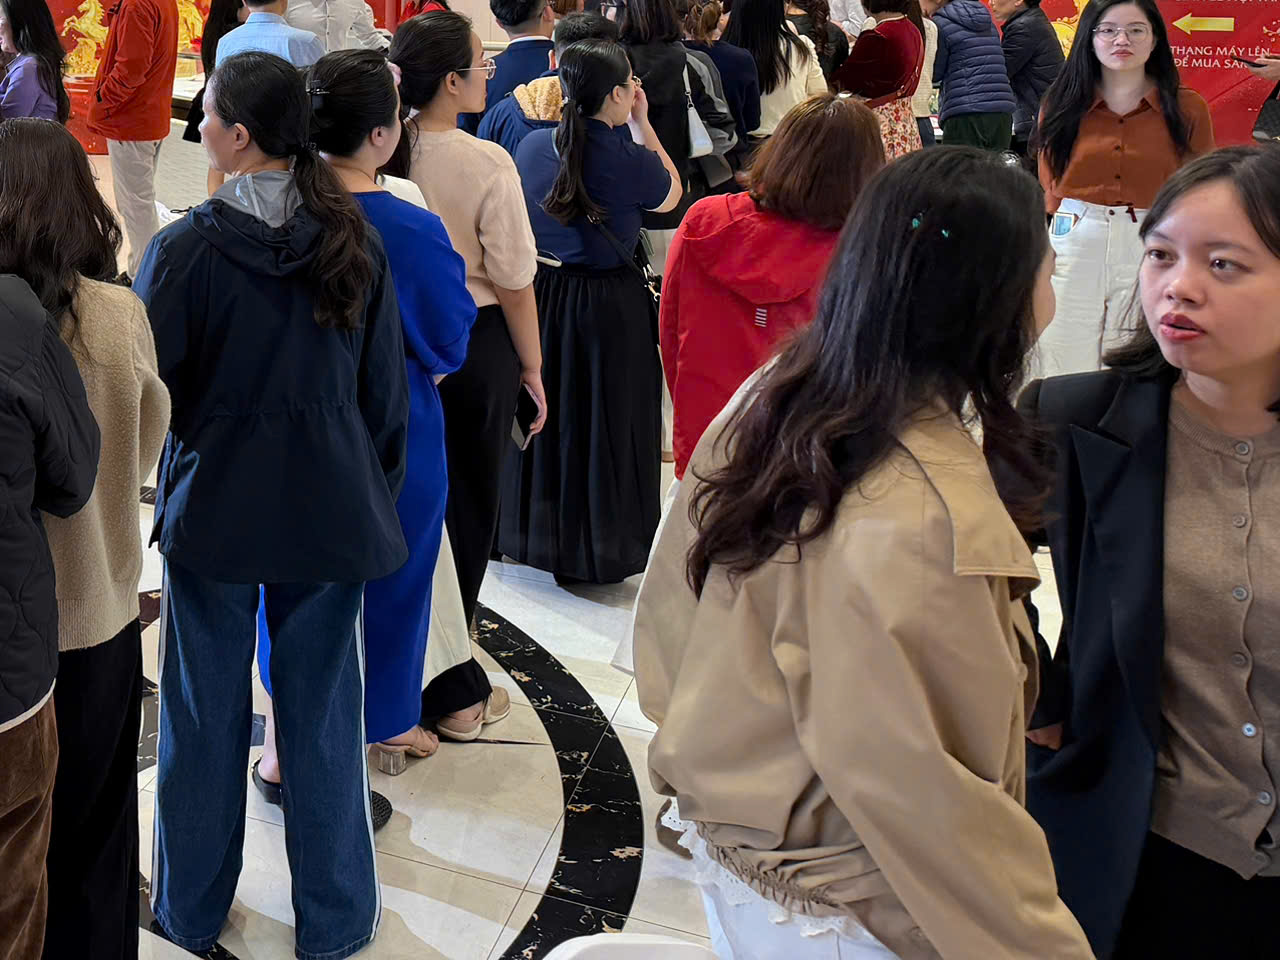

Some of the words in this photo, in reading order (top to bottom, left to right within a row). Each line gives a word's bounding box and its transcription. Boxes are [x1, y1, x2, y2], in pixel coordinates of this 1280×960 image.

[1170, 45, 1213, 56] THANG
[1215, 45, 1245, 56] MÁY
[1248, 45, 1270, 57] LÊN
[1191, 58, 1221, 68] MUA
